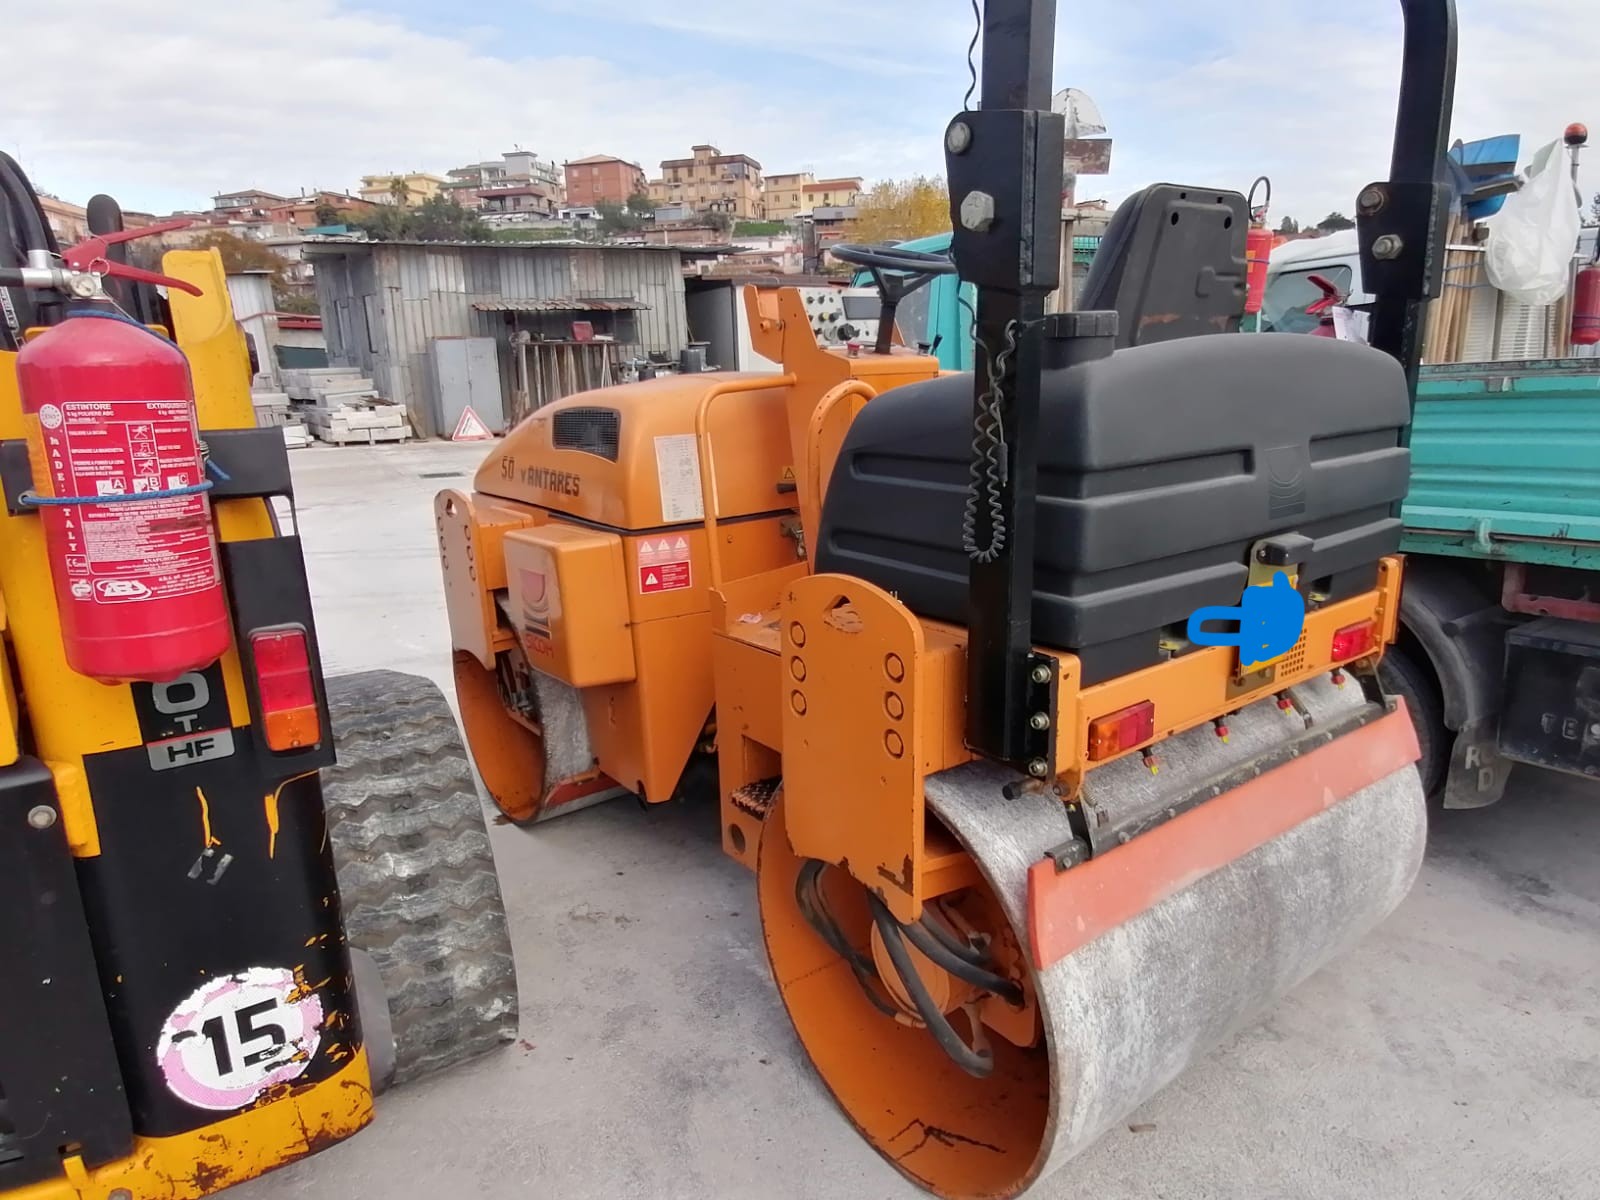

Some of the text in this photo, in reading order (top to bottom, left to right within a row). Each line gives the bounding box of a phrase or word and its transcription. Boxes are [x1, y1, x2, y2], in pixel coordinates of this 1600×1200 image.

[65, 403, 112, 411] ESTINTORE
[501, 456, 515, 481] 50
[149, 477, 159, 487] B
[167, 737, 215, 763] HF
[201, 997, 287, 1077] 15
